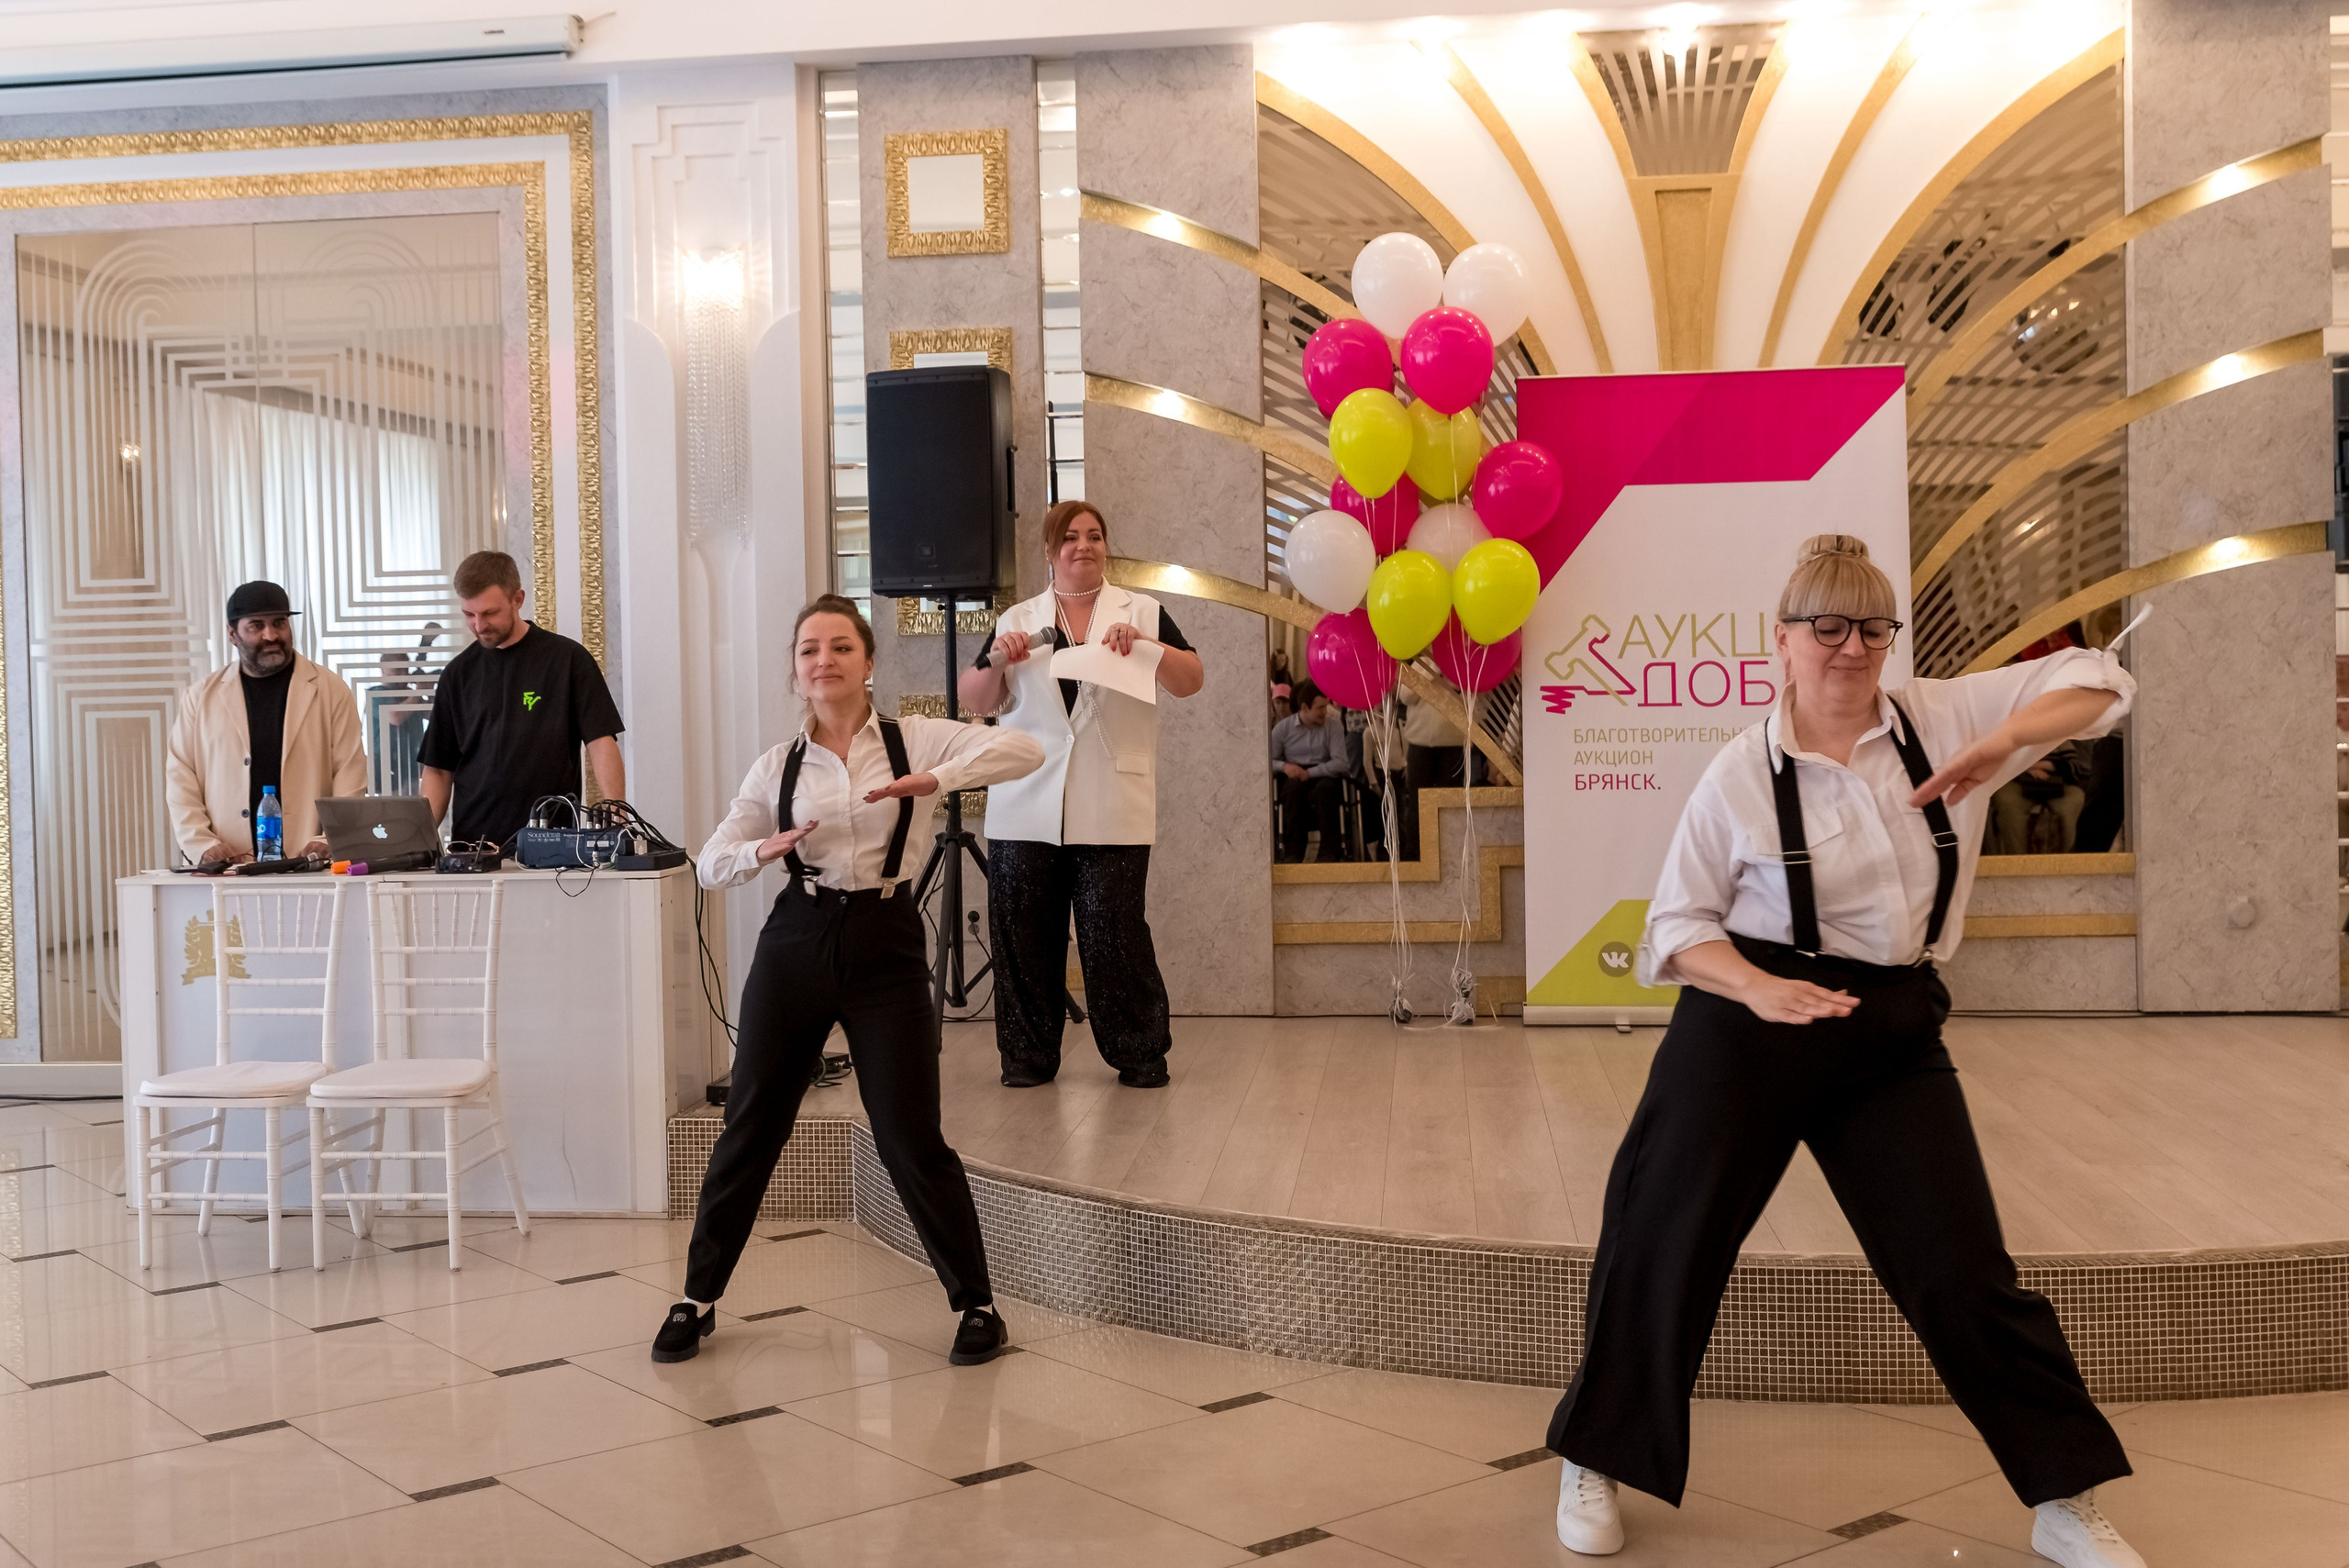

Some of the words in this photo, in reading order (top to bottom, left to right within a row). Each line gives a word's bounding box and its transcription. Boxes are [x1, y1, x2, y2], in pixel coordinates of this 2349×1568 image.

[1618, 612, 1774, 659] АУКЦ
[1638, 660, 1776, 707] ДОБ
[1574, 727, 1748, 744] БЛАГОТВОРИТЕЛЬН
[1574, 750, 1653, 767] АУКЦИОН
[1575, 773, 1662, 791] БРЯНСК.
